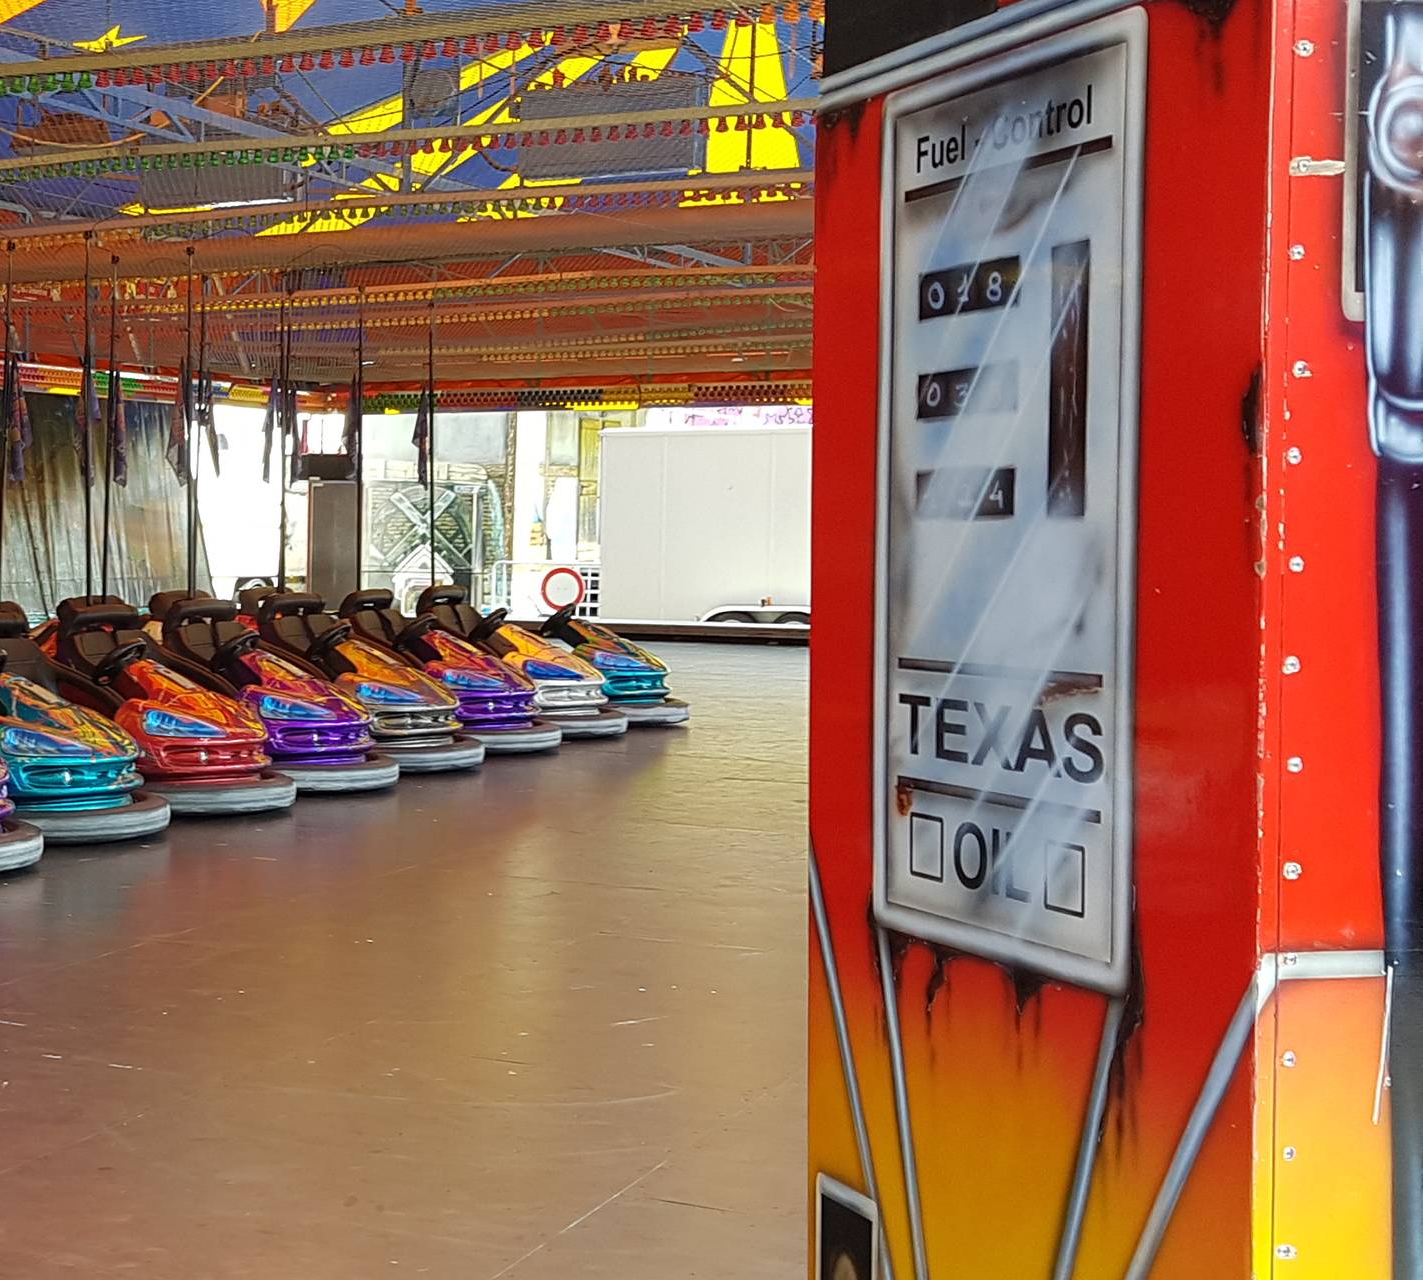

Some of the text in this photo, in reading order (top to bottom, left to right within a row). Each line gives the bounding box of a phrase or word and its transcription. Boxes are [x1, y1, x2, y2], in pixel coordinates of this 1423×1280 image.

[917, 124, 965, 173] Fuel
[992, 84, 1092, 150] Control
[899, 694, 1105, 785] TEXAS
[953, 822, 1031, 903] OIL
